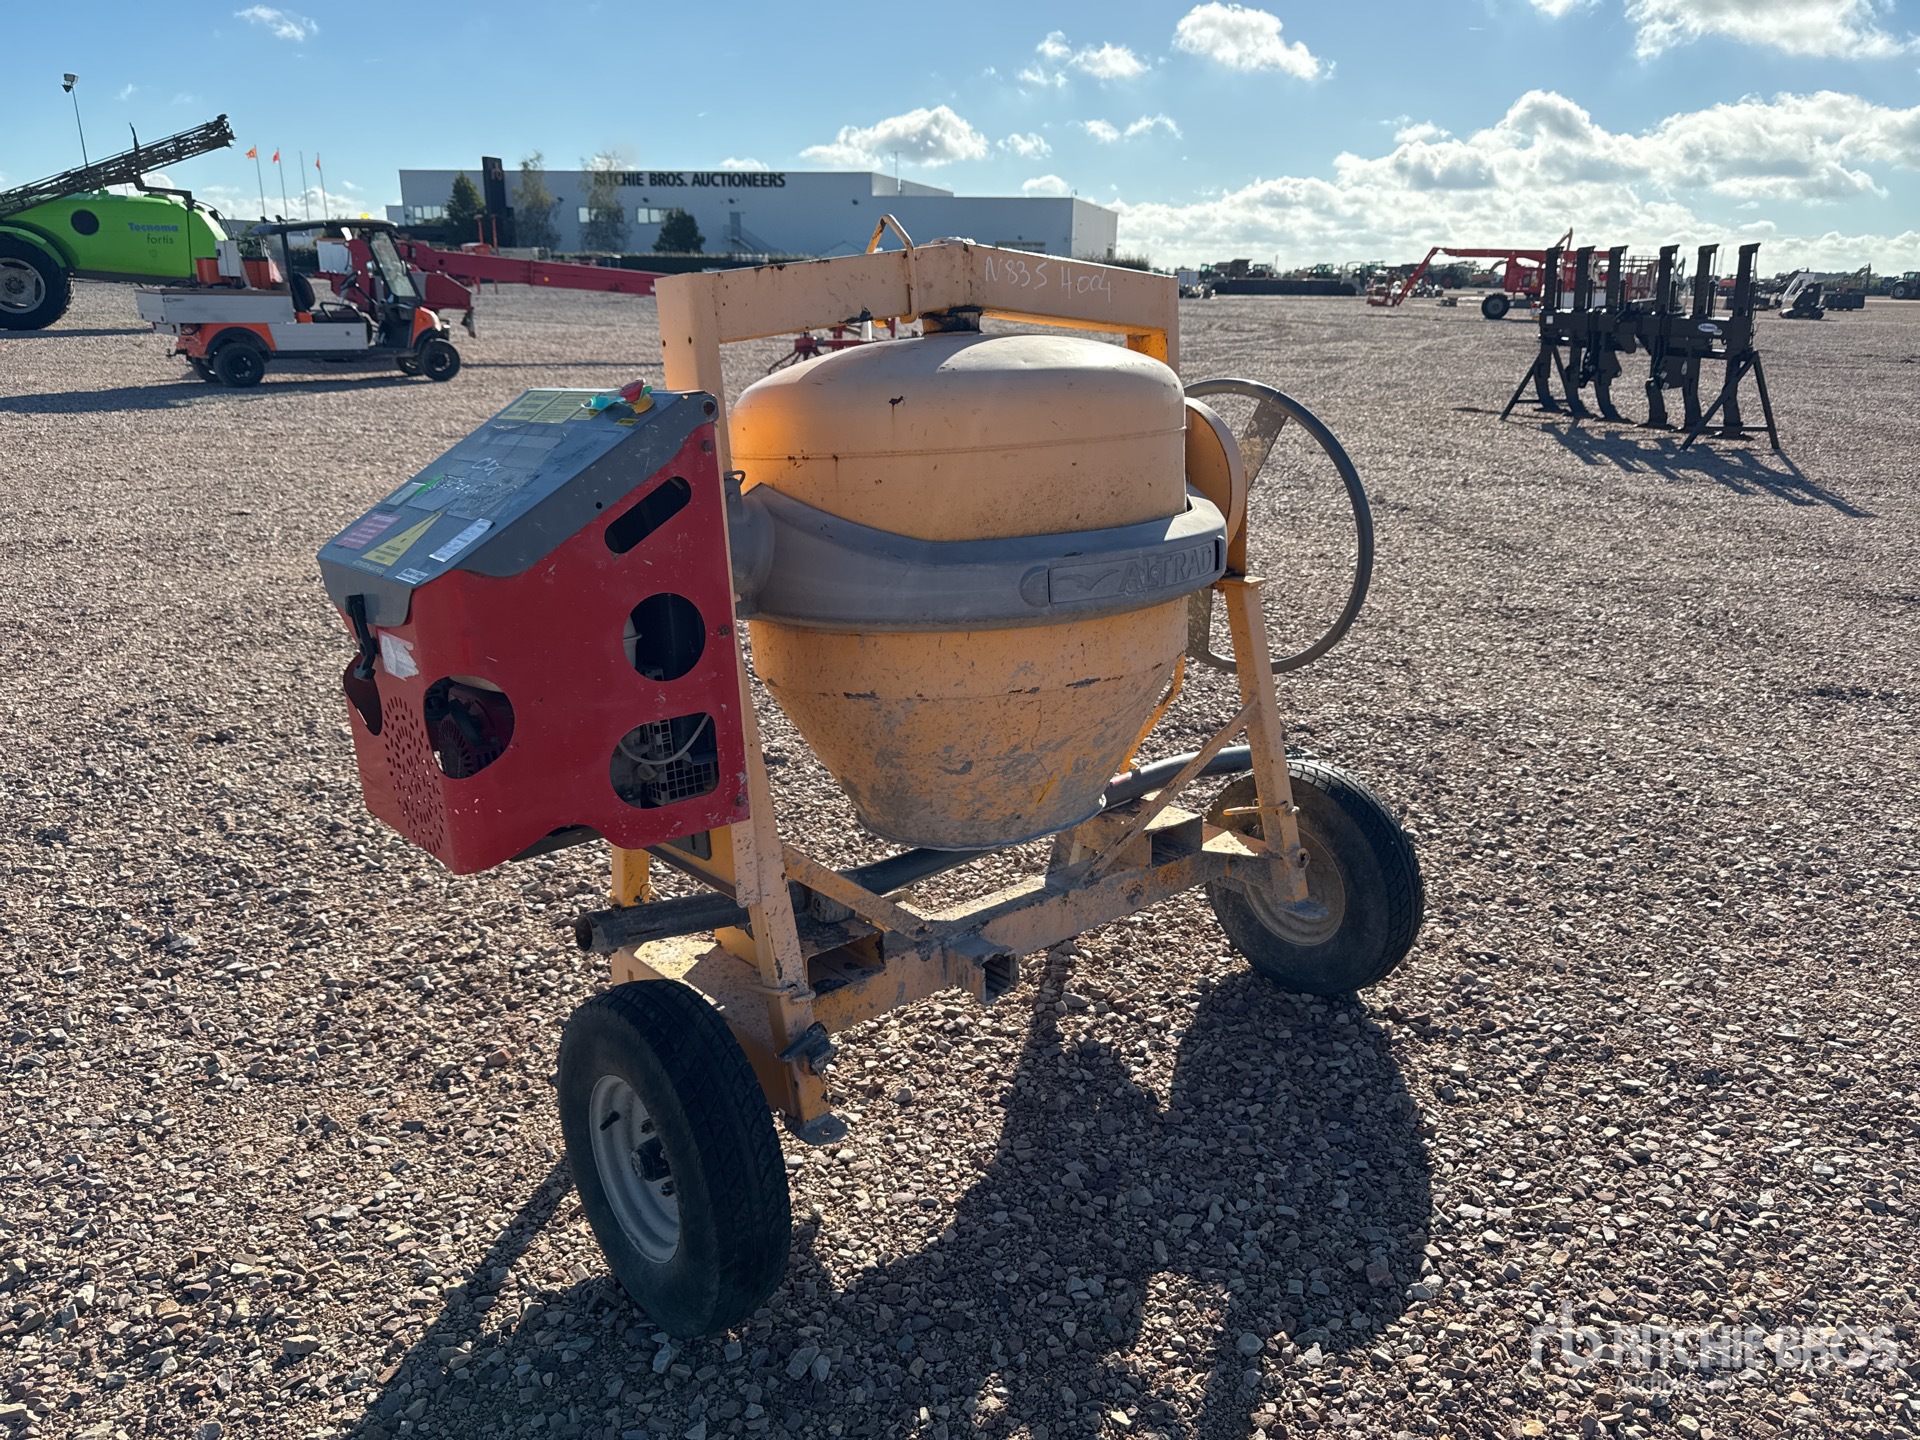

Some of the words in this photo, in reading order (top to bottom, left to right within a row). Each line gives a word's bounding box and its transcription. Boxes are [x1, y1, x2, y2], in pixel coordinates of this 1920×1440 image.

[649, 172, 688, 187] BROS.
[691, 173, 786, 188] AUCTIONEERS
[128, 222, 179, 232] Tecnoma
[146, 233, 174, 245] fortis
[1118, 545, 1212, 594] ALTRAD
